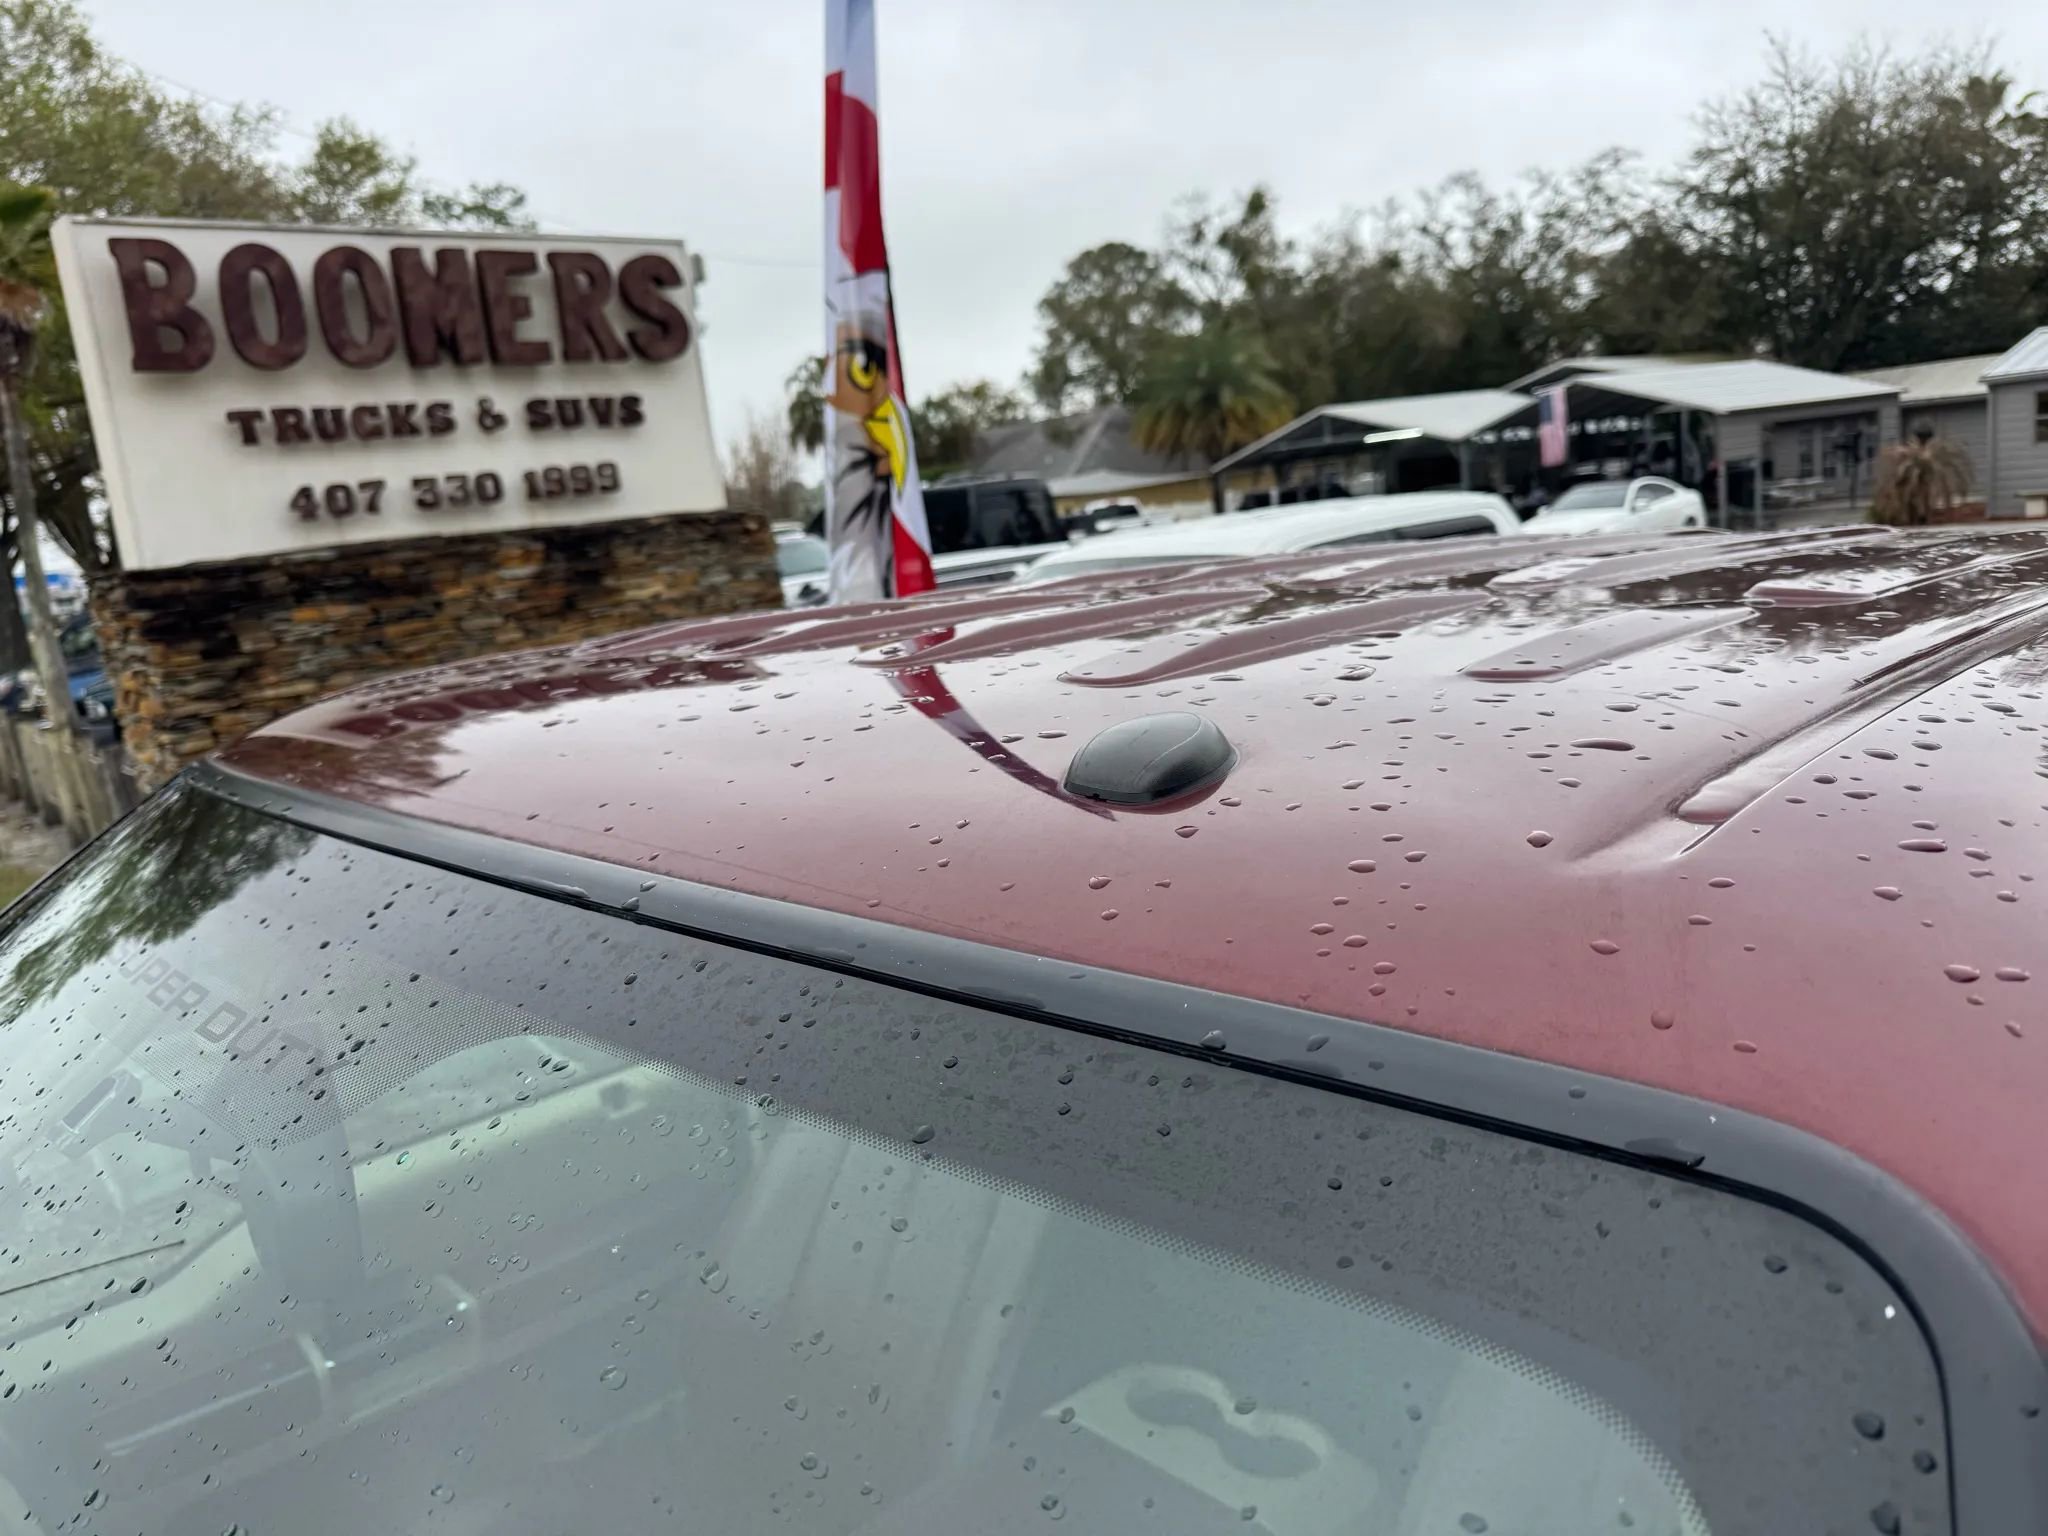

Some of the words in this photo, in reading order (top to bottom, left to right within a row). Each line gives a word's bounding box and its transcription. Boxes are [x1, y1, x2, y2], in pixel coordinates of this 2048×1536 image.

[108, 238, 690, 372] BOOMERS
[228, 403, 455, 446] TRUCKS
[478, 397, 507, 432] &
[527, 396, 644, 430] SUVS
[290, 480, 386, 521] 407
[413, 472, 503, 510] 330
[524, 463, 621, 501] 1999
[193, 1000, 353, 1092] DUTY
